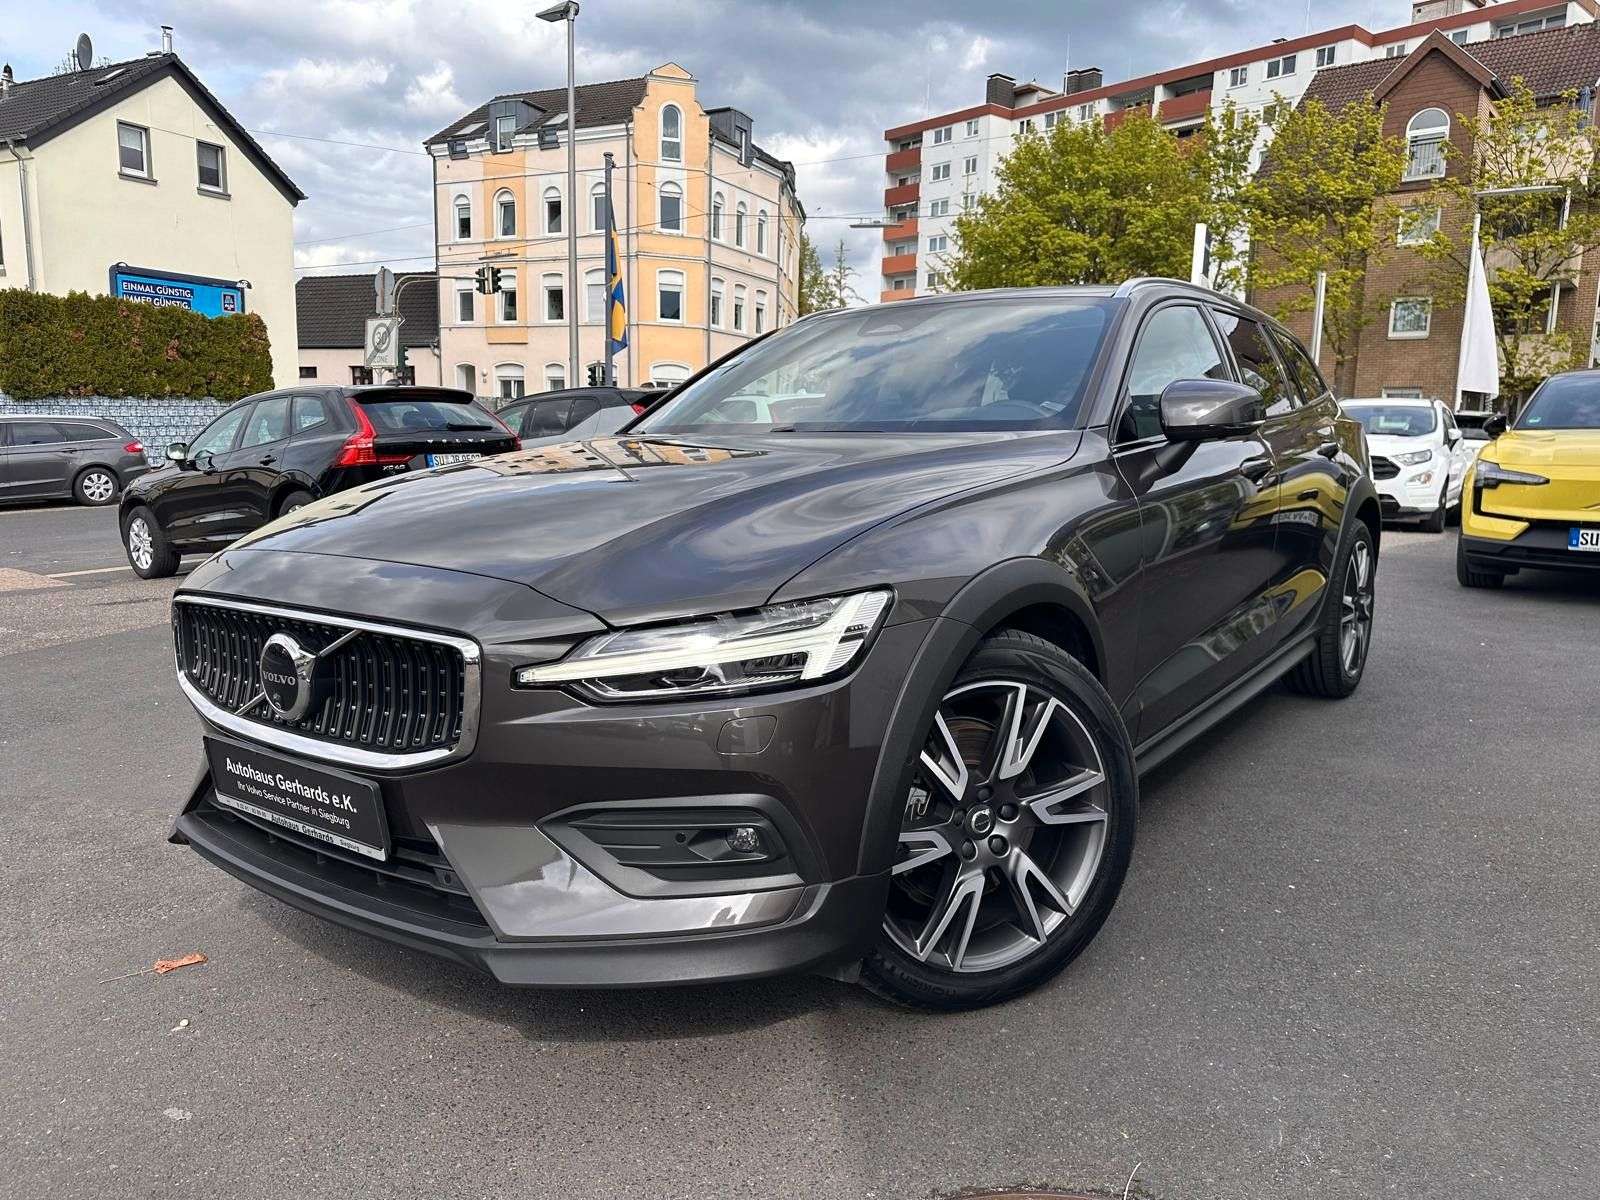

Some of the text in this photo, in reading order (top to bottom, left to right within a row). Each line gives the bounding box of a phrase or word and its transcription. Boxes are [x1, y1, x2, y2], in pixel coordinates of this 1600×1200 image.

[122, 281, 193, 298] EINMAL GÜNSTIG.
[1580, 532, 1600, 546] SU
[263, 670, 296, 686] VOLVO
[226, 757, 358, 813] Autohaus Gerhards e.K.
[237, 780, 351, 829] Ihr Volvo Service Partner in Siegburg
[271, 813, 300, 831] Autohaus
[302, 826, 334, 842] Gerhards
